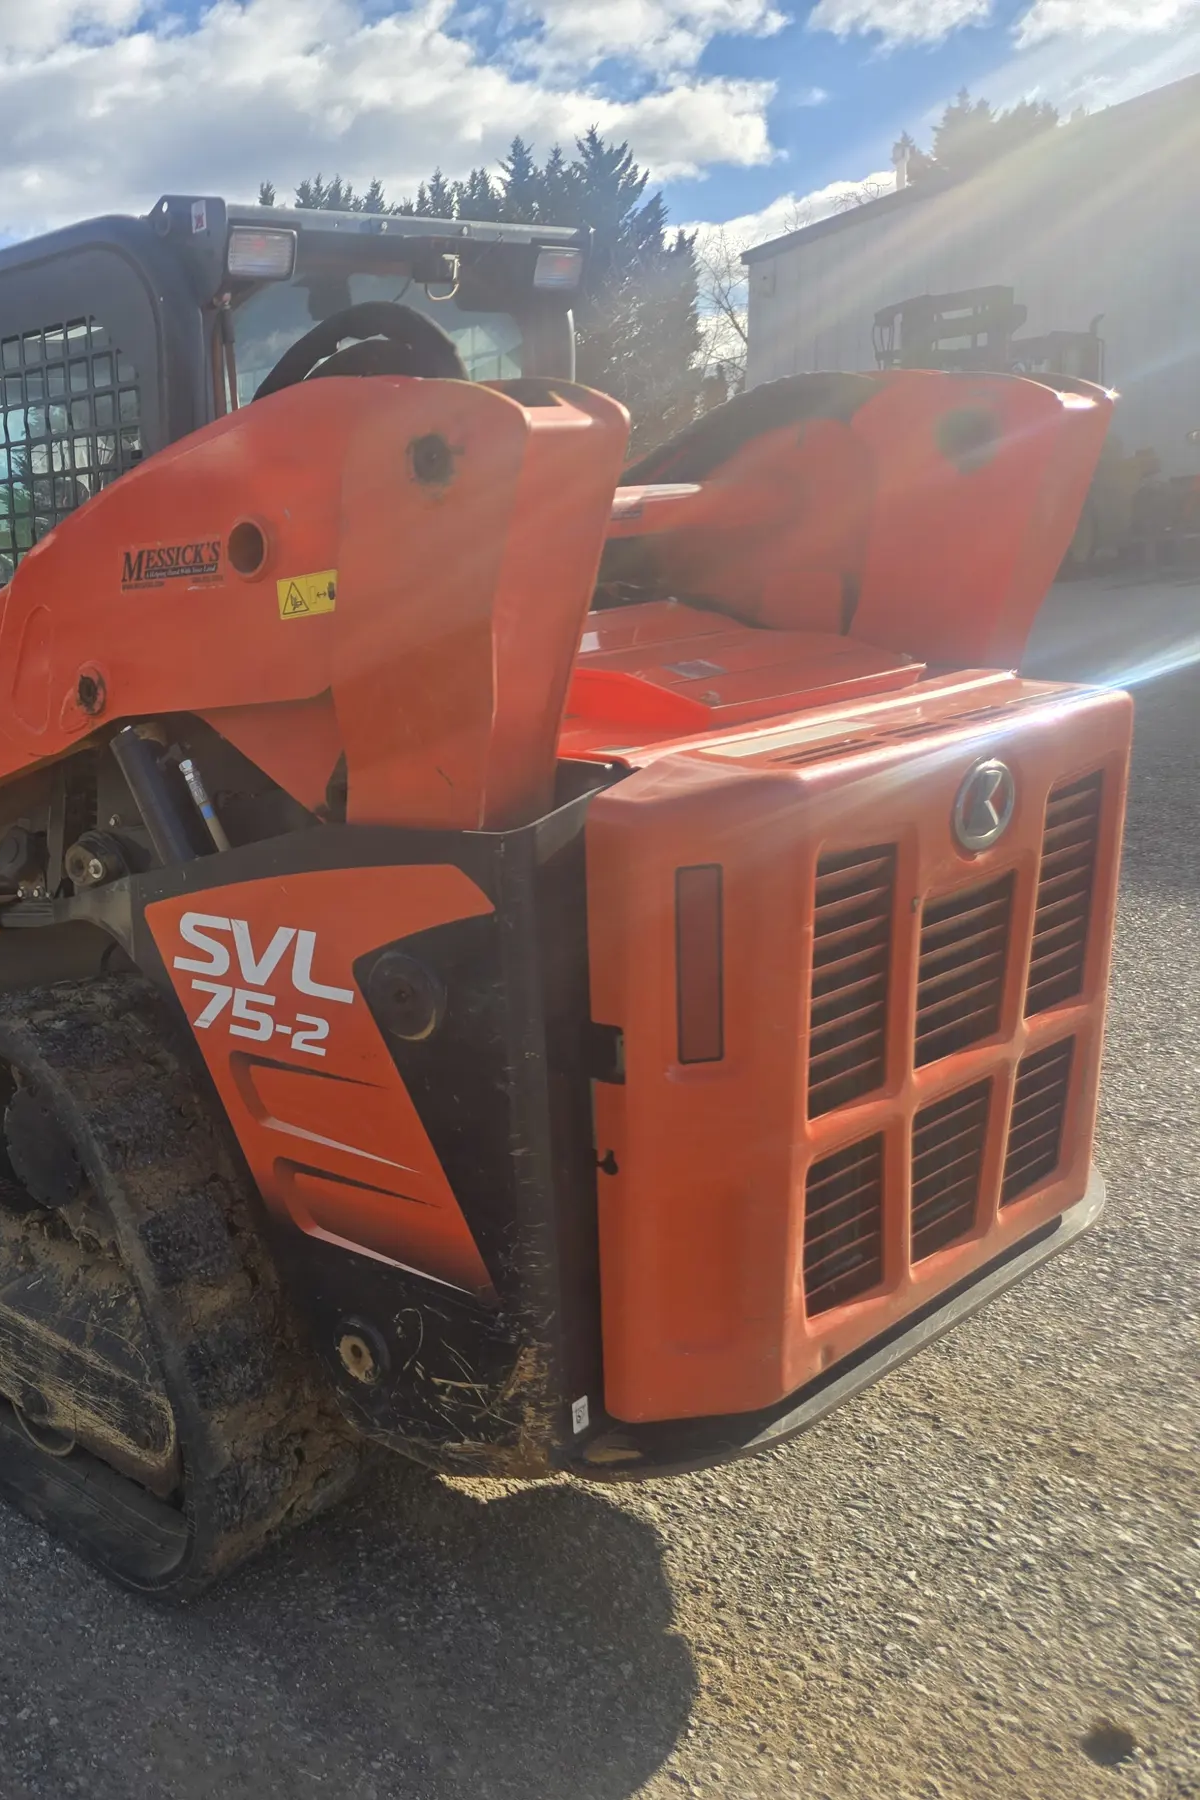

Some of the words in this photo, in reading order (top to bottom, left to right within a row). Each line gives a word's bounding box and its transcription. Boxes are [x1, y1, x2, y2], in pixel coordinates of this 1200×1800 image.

[121, 541, 220, 583] MESSICK'S
[173, 911, 354, 1004] SVL
[191, 979, 330, 1056] 75-2
